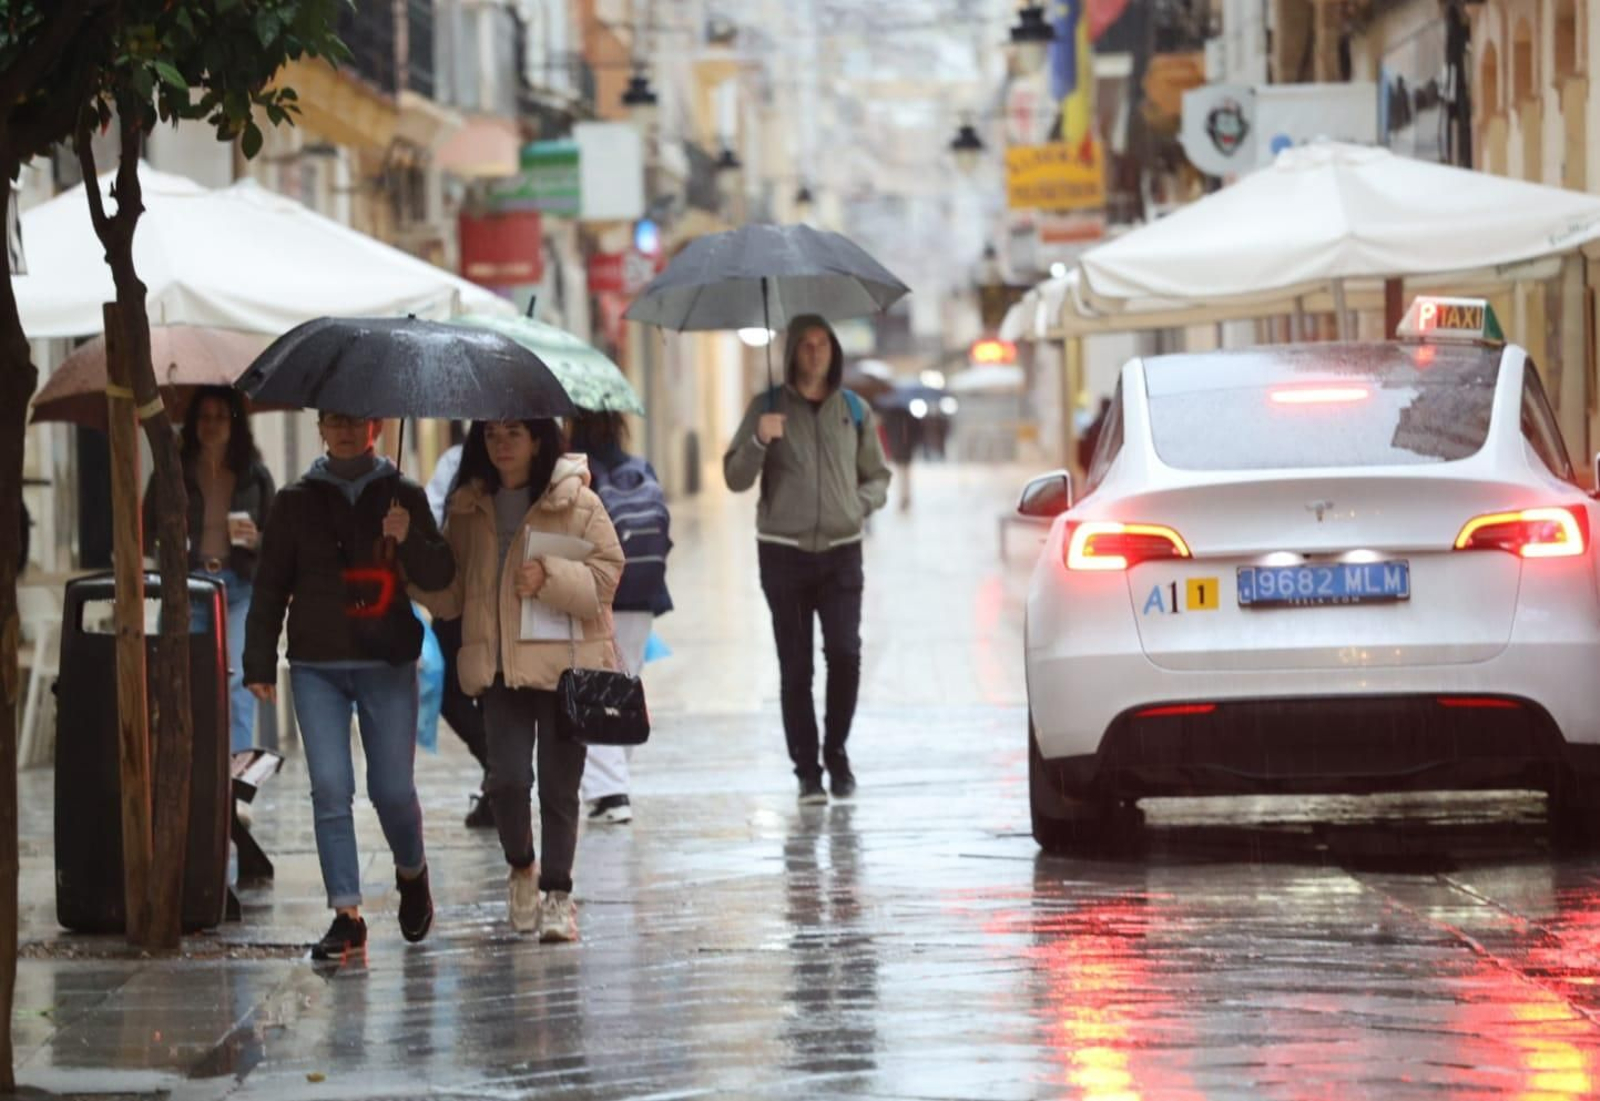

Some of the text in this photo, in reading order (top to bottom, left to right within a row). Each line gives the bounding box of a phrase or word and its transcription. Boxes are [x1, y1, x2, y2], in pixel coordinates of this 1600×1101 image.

[1419, 302, 1481, 330] P TAXI
[1197, 584, 1205, 606] 1
[1258, 566, 1401, 597] 9682 MLM
